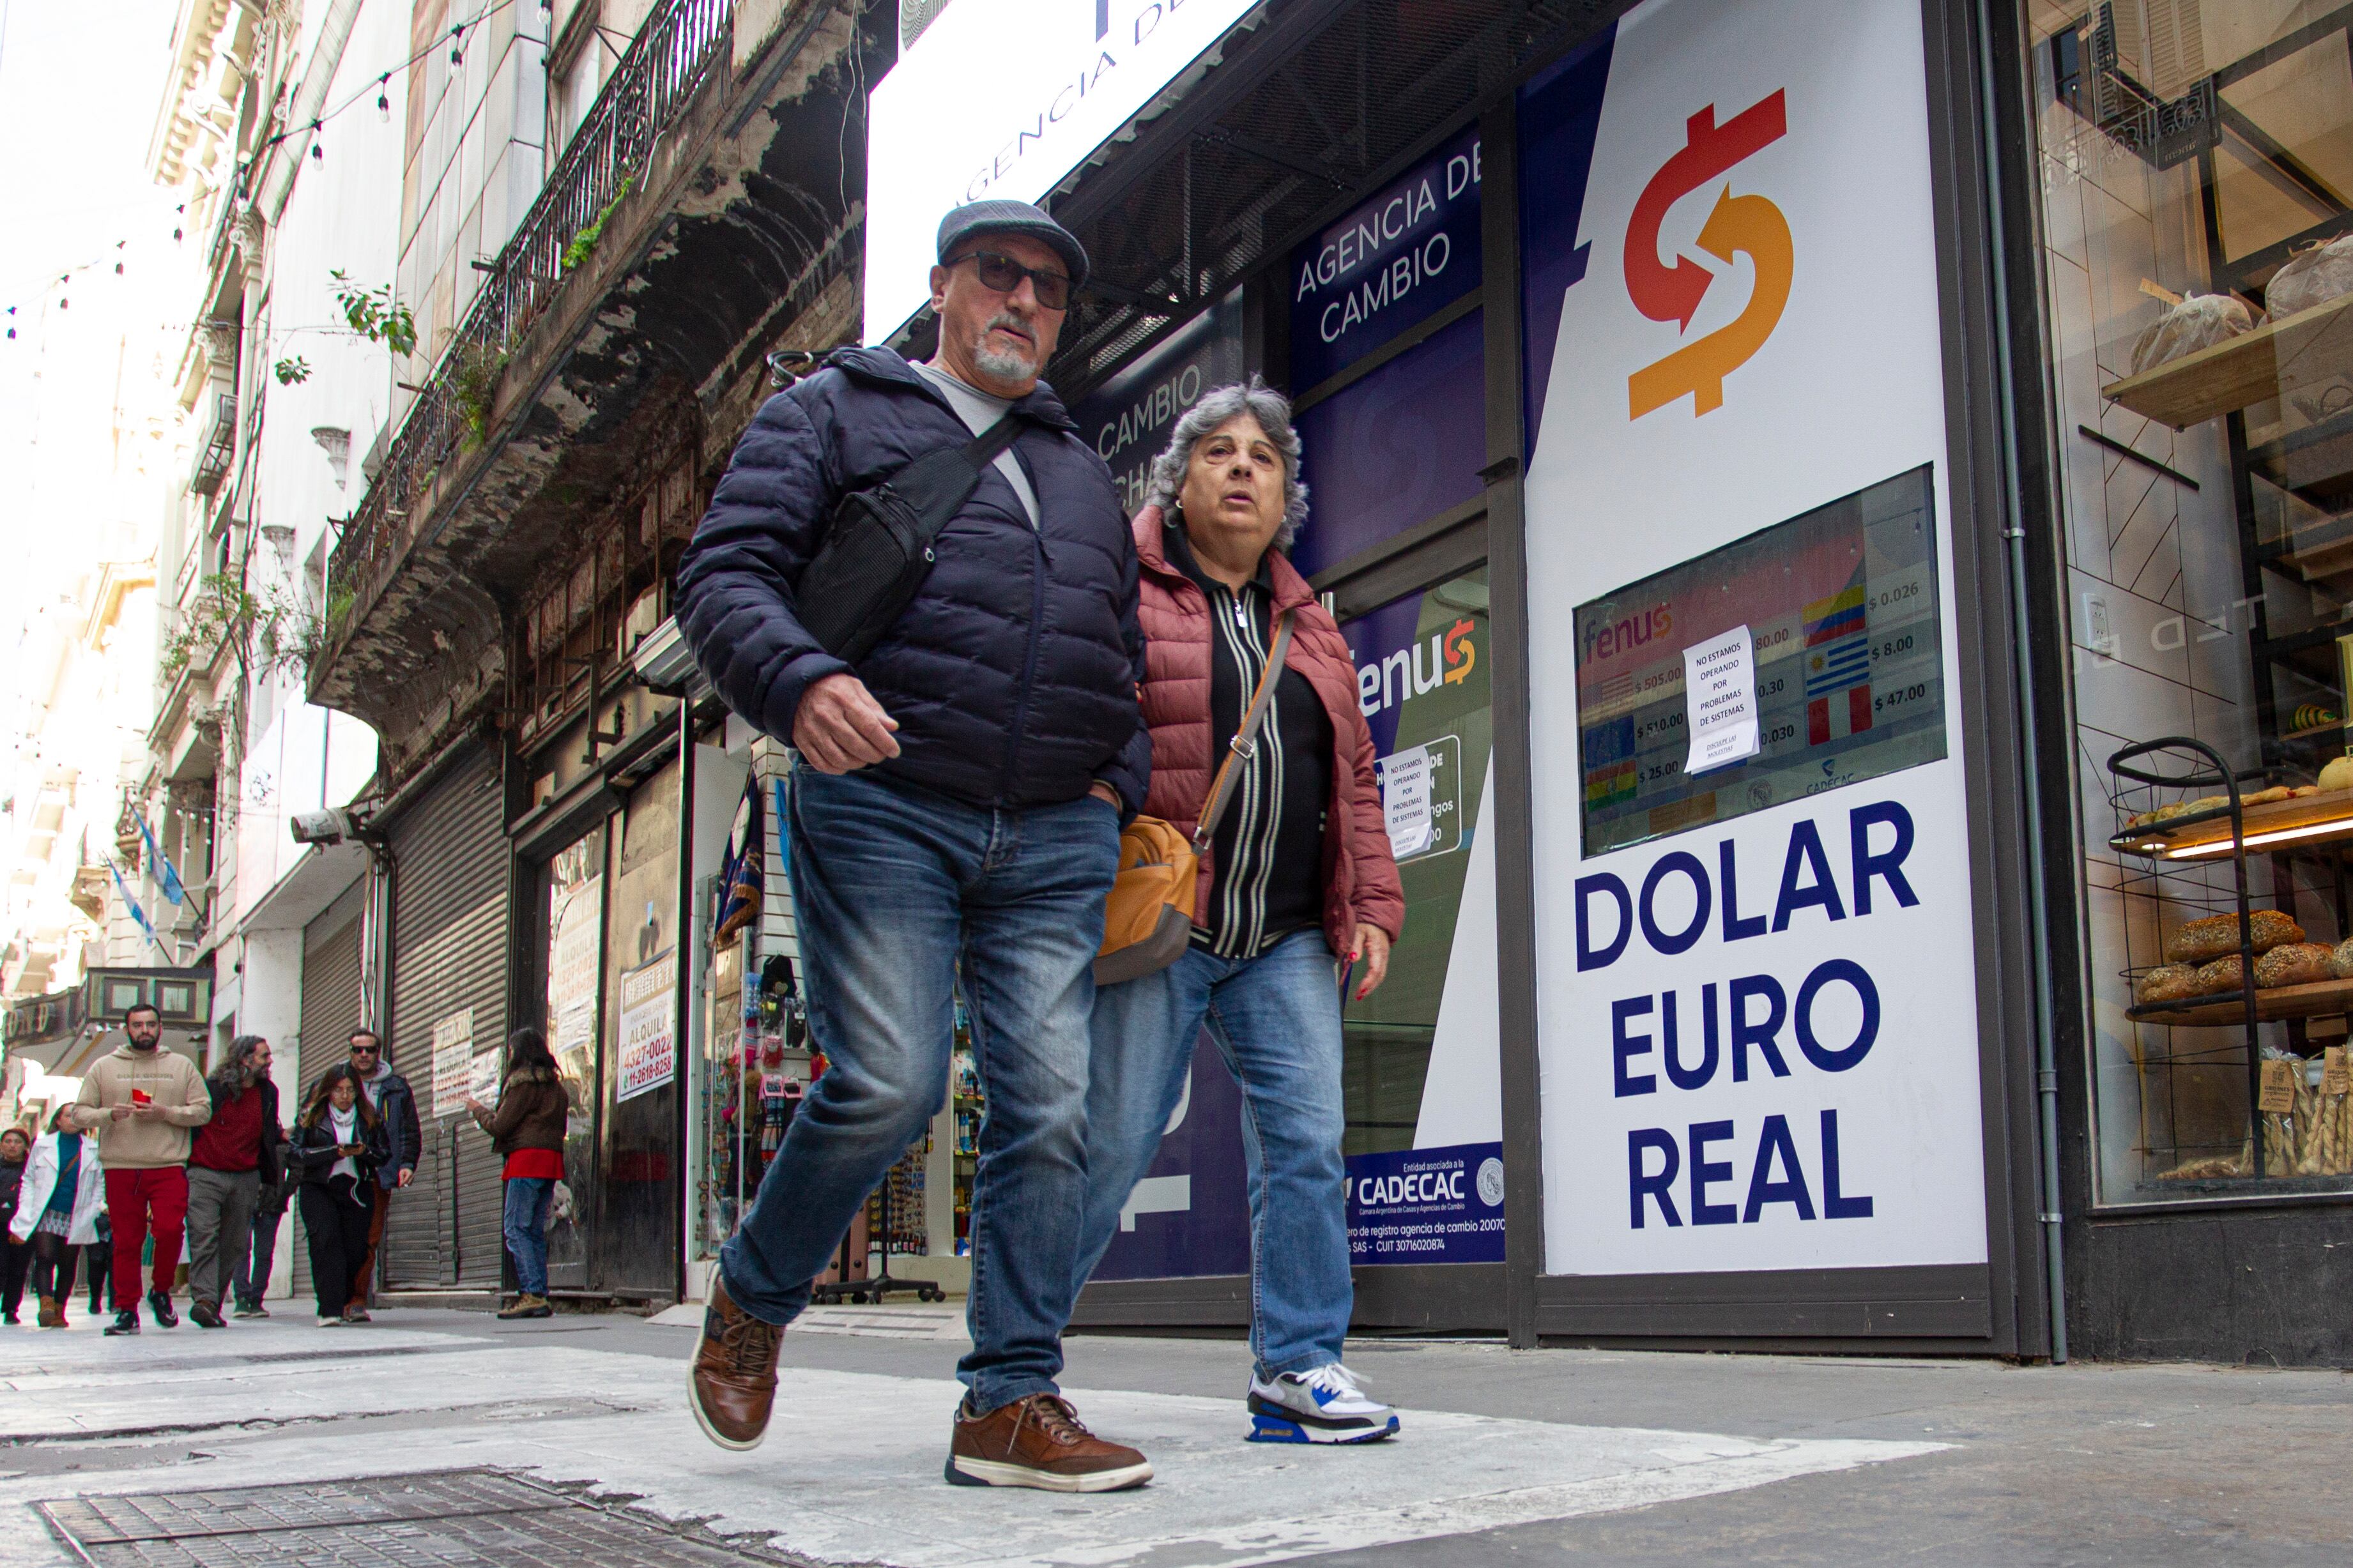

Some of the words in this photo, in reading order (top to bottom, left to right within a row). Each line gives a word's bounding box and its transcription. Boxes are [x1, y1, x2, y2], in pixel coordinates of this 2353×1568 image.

[956, 51, 1117, 206] GENCIA
[1135, 0, 1185, 47] D
[1297, 178, 1436, 303] AGENCIA
[1320, 232, 1450, 343] CAMBIO
[1098, 364, 1200, 494] CAMBIO
[1881, 582, 1919, 607] 0.026
[1696, 656, 1708, 667] NO
[1708, 642, 1742, 662] ESTAMOS
[1884, 635, 1914, 657] 8.00
[1349, 618, 1475, 719] enus
[1644, 667, 1682, 692] 505.00
[1699, 659, 1740, 681] OPERANDO
[1712, 679, 1728, 691] POR
[1758, 678, 1785, 698] 0.30
[1887, 683, 1926, 706] 47.00
[1700, 689, 1742, 711] PROBLEMAS
[1646, 712, 1683, 733] 510.00
[1699, 716, 1710, 727] DE
[1710, 703, 1745, 723] SISTEMAS
[1726, 734, 1737, 745] LAS
[1390, 766, 1399, 775] NO
[1399, 757, 1423, 772] ESTAMOS
[1648, 761, 1679, 780] 25.00
[1393, 771, 1422, 786] OPERANDO
[1805, 773, 1855, 796] CADECAC
[1402, 787, 1413, 796] POR
[1392, 796, 1423, 812] PROBLEMAS
[1392, 816, 1400, 824] DE
[1399, 808, 1424, 822] SISTEMAS
[1574, 800, 1921, 973] DOLAR
[629, 1012, 668, 1047] ALQUILA
[1611, 958, 1881, 1099] EURO
[624, 1033, 673, 1070] 4327-0022
[629, 1054, 672, 1088] 11-2618-8258
[1403, 1162, 1425, 1173] Entidad
[1426, 1161, 1453, 1171] asociada
[1458, 1159, 1464, 1168] la
[1628, 1109, 1874, 1230] REAL
[1359, 1171, 1465, 1205] CADECAC
[1376, 1206, 1397, 1215] Argentina
[1402, 1205, 1416, 1214] Casas
[1420, 1204, 1440, 1214] Agencias
[1447, 1202, 1465, 1211] Cambio
[1359, 1226, 1370, 1237] de
[1371, 1224, 1399, 1238] registro
[1400, 1222, 1433, 1237] agencia
[1434, 1221, 1446, 1233] de
[1446, 1219, 1479, 1233] cambio
[1353, 1241, 1367, 1252] SAS
[1376, 1240, 1395, 1252] CUIT
[1395, 1238, 1445, 1252] 30716020874
